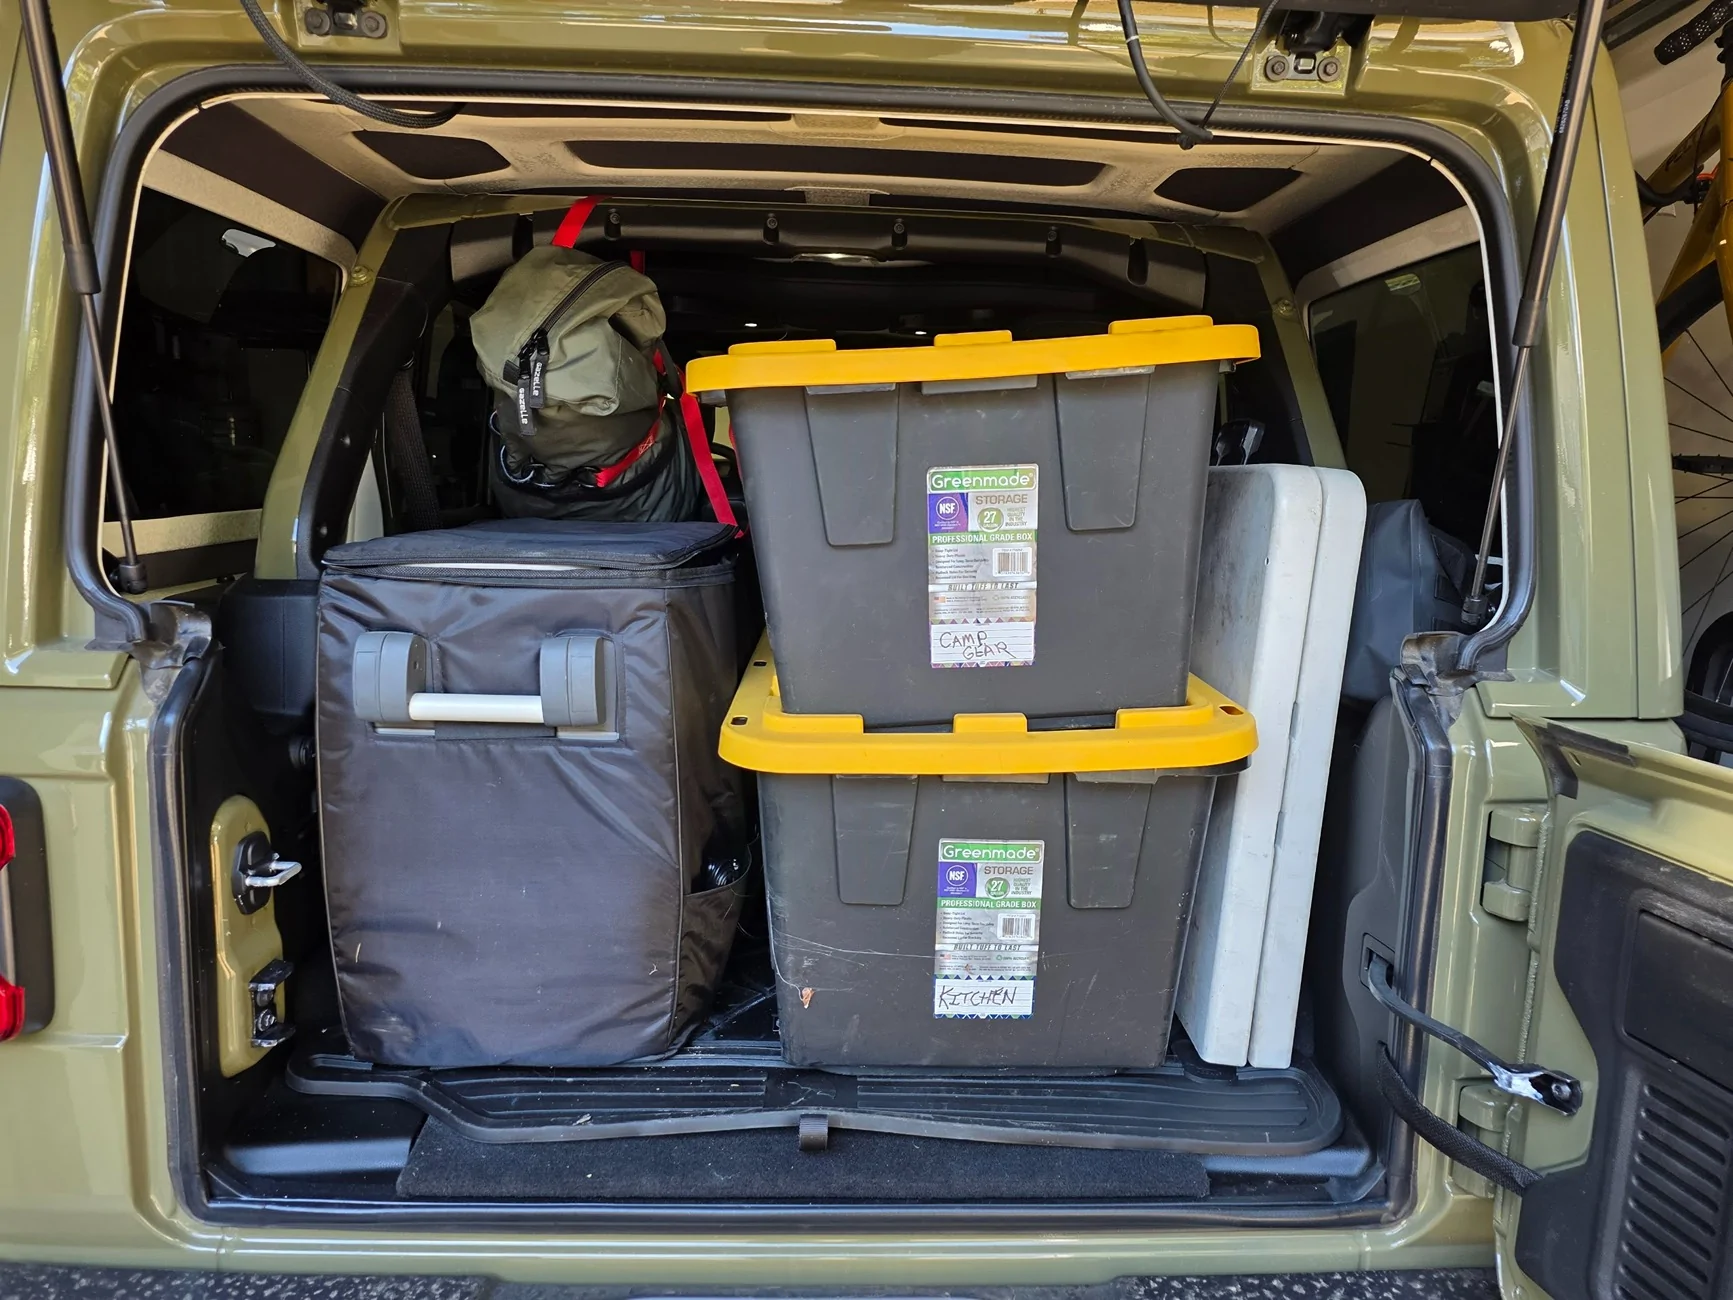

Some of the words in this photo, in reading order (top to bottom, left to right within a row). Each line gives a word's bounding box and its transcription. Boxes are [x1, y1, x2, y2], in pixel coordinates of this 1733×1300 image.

[931, 471, 1030, 489] Greenmade
[975, 493, 1029, 505] STORAGE
[939, 502, 956, 515] NSF
[983, 511, 997, 524] 27
[932, 534, 988, 544] PROFESSIONAL
[989, 533, 1016, 542] GRADE
[1016, 532, 1033, 541] BOX
[1000, 582, 1019, 590] LAST
[939, 630, 988, 648] CAMP
[962, 641, 1017, 660] GEAR
[943, 845, 1036, 859] Greenmade
[949, 870, 965, 881] NSF
[984, 865, 1034, 875] STORAGE
[990, 880, 1004, 892] 27
[940, 899, 994, 908] PROFESSIONAL
[995, 900, 1020, 908] GRADE
[1021, 900, 1037, 908] BOX
[938, 985, 1018, 1010] KITCHEN
